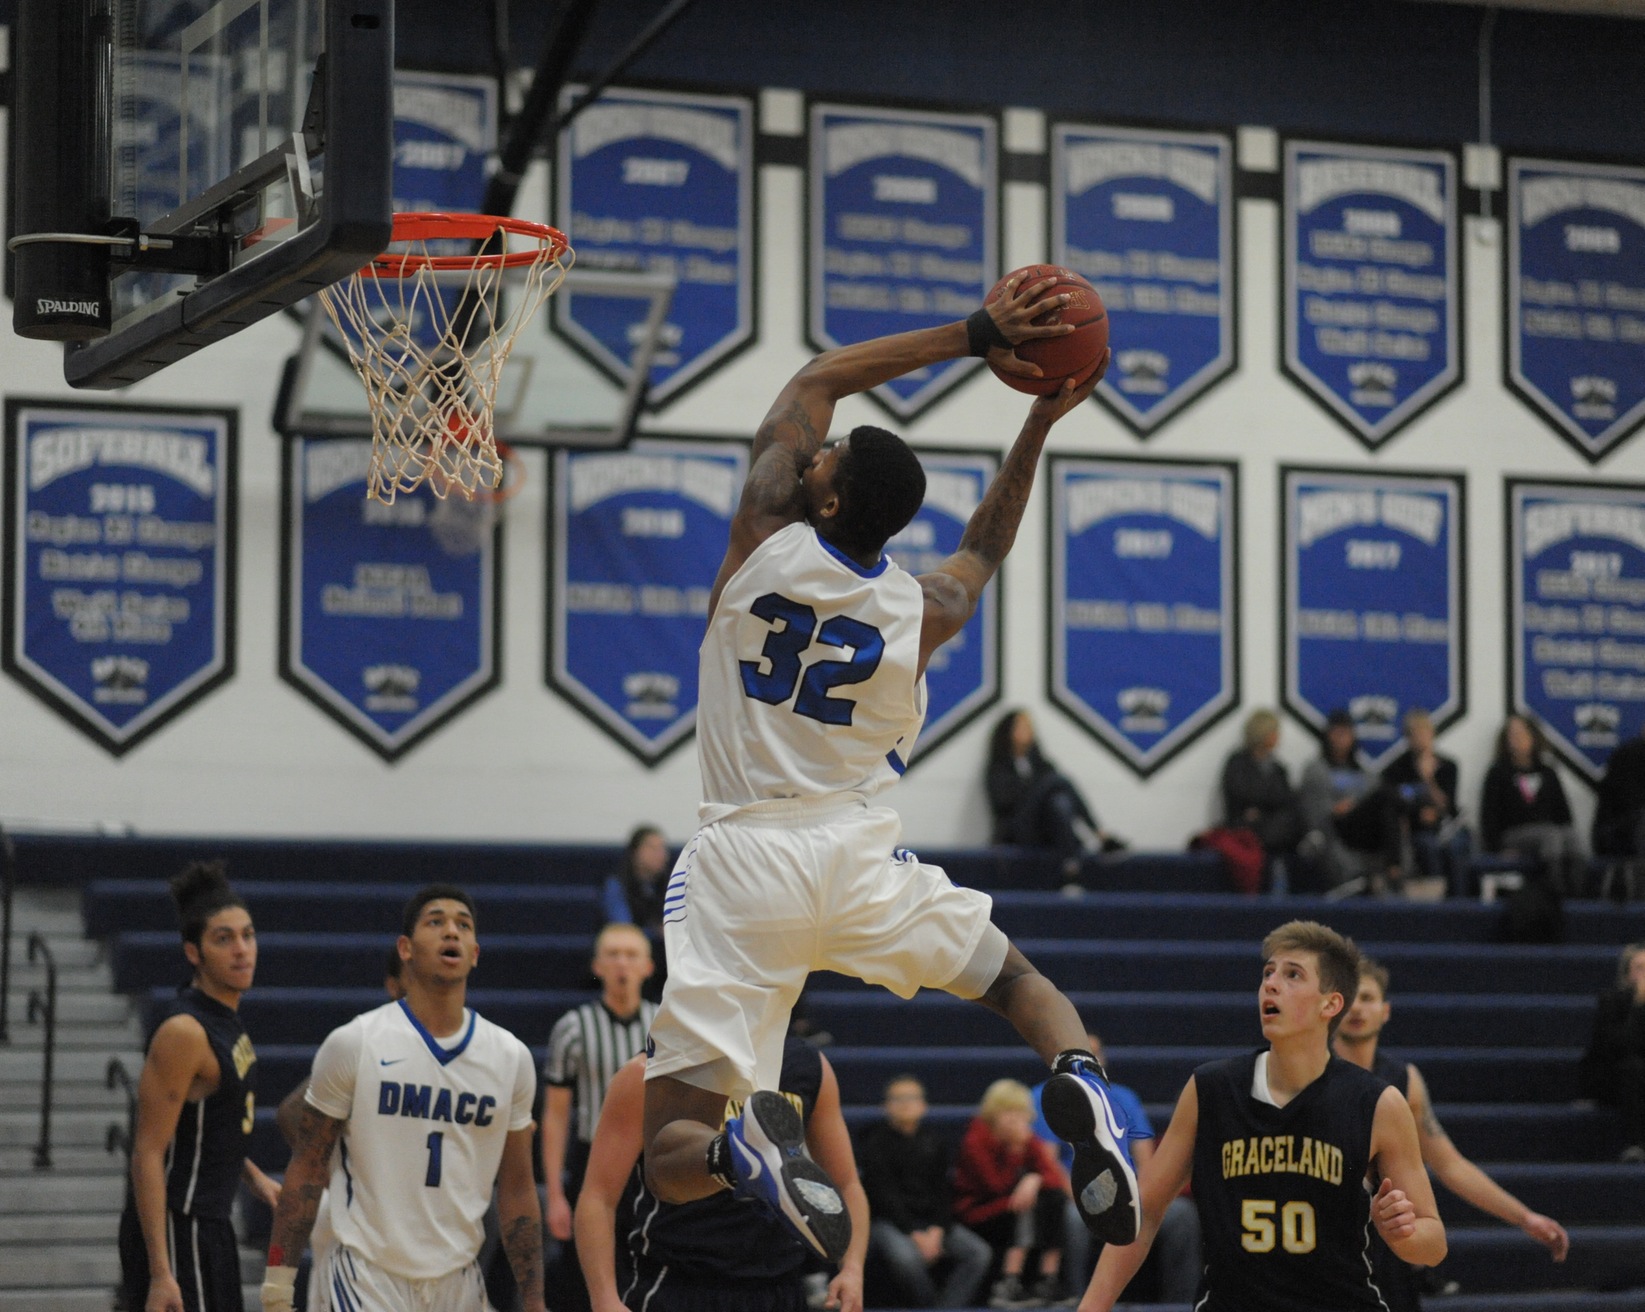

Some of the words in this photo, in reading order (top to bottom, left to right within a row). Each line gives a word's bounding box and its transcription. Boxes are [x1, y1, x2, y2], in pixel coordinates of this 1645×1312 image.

[37, 299, 100, 318] SPALDING
[30, 428, 213, 493] SOFTBALL
[739, 592, 885, 726] 32
[378, 1081, 497, 1126] DMACC
[425, 1131, 444, 1188] 1
[1222, 1135, 1344, 1186] GRACELAND
[1241, 1199, 1316, 1254] 50
